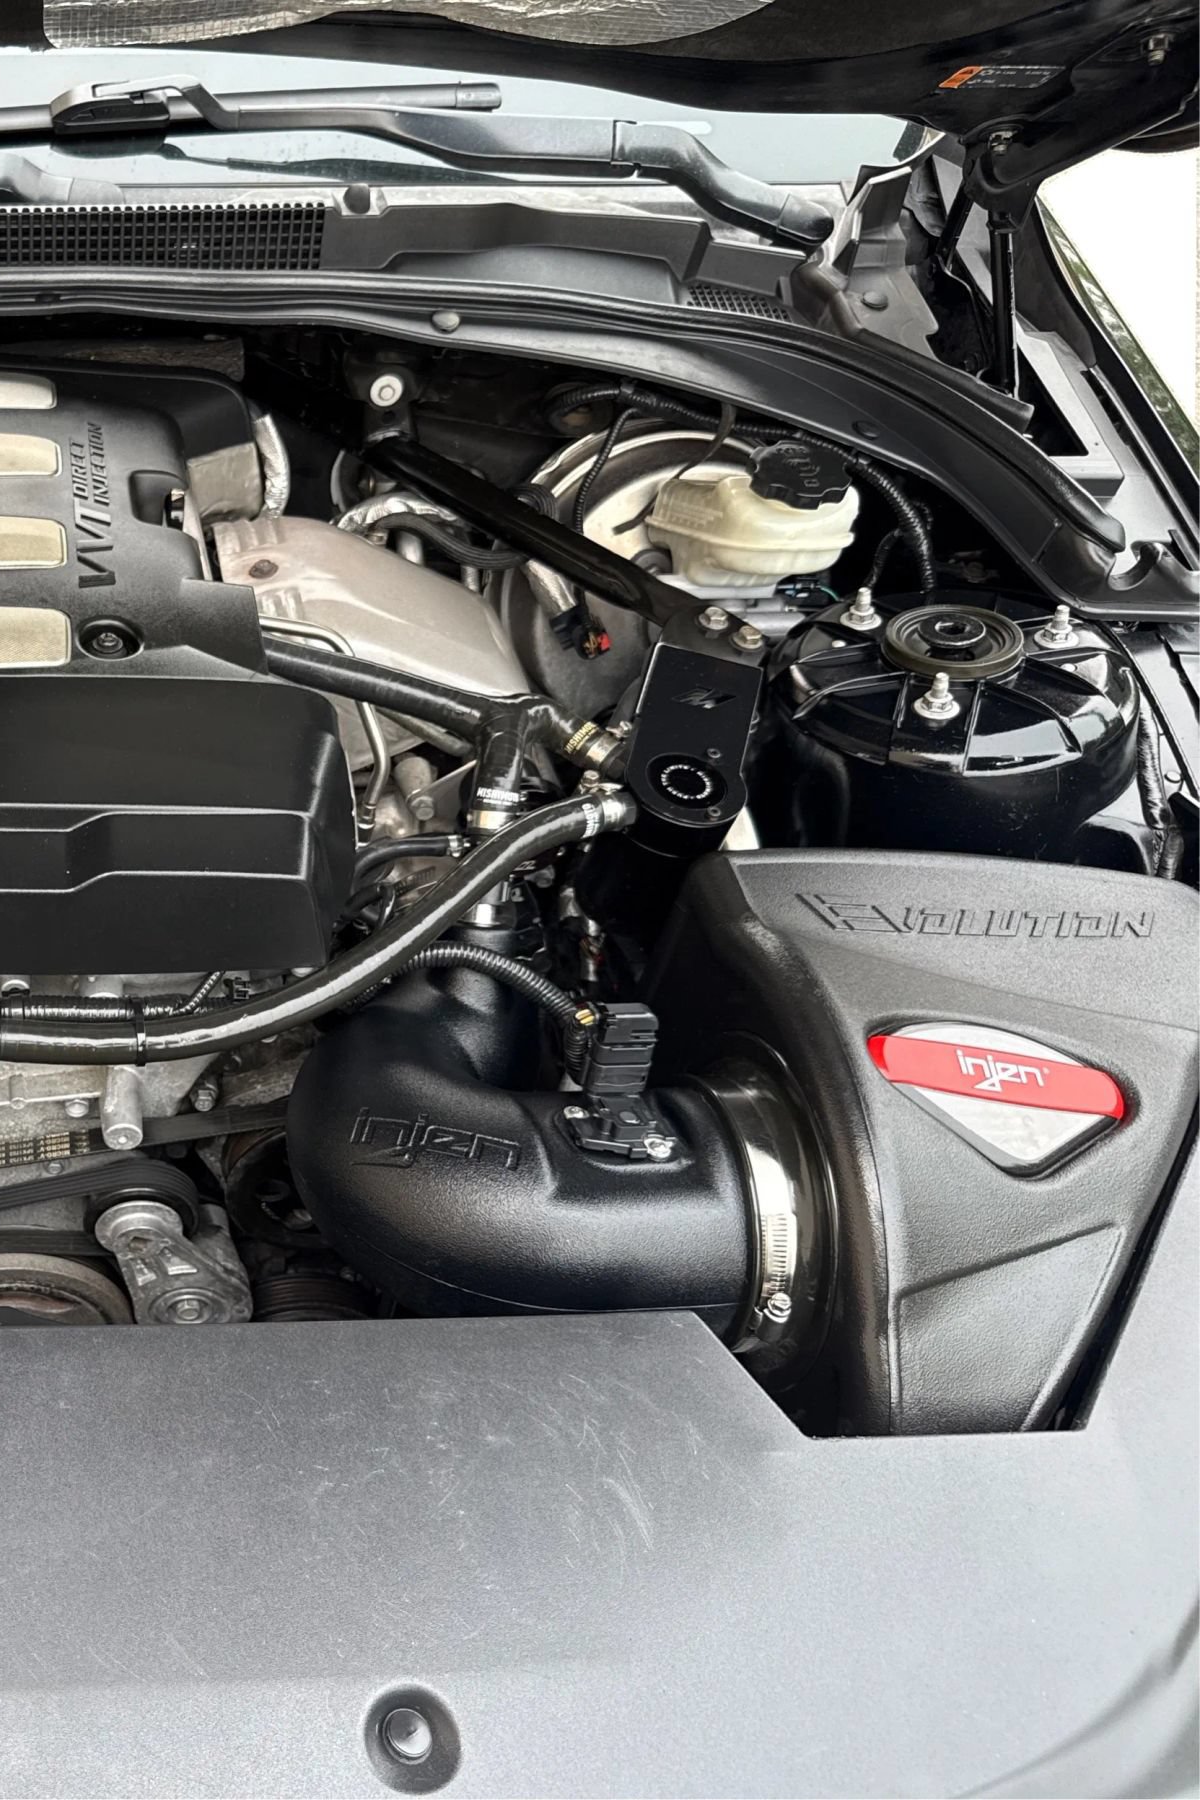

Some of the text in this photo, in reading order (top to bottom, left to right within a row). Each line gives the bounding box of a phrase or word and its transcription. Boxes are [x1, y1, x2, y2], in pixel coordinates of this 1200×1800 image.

[69, 437, 89, 501] DIRECT
[88, 421, 110, 507] INJECTION
[74, 497, 117, 589] VVT
[795, 893, 1155, 938] EVOLUTION
